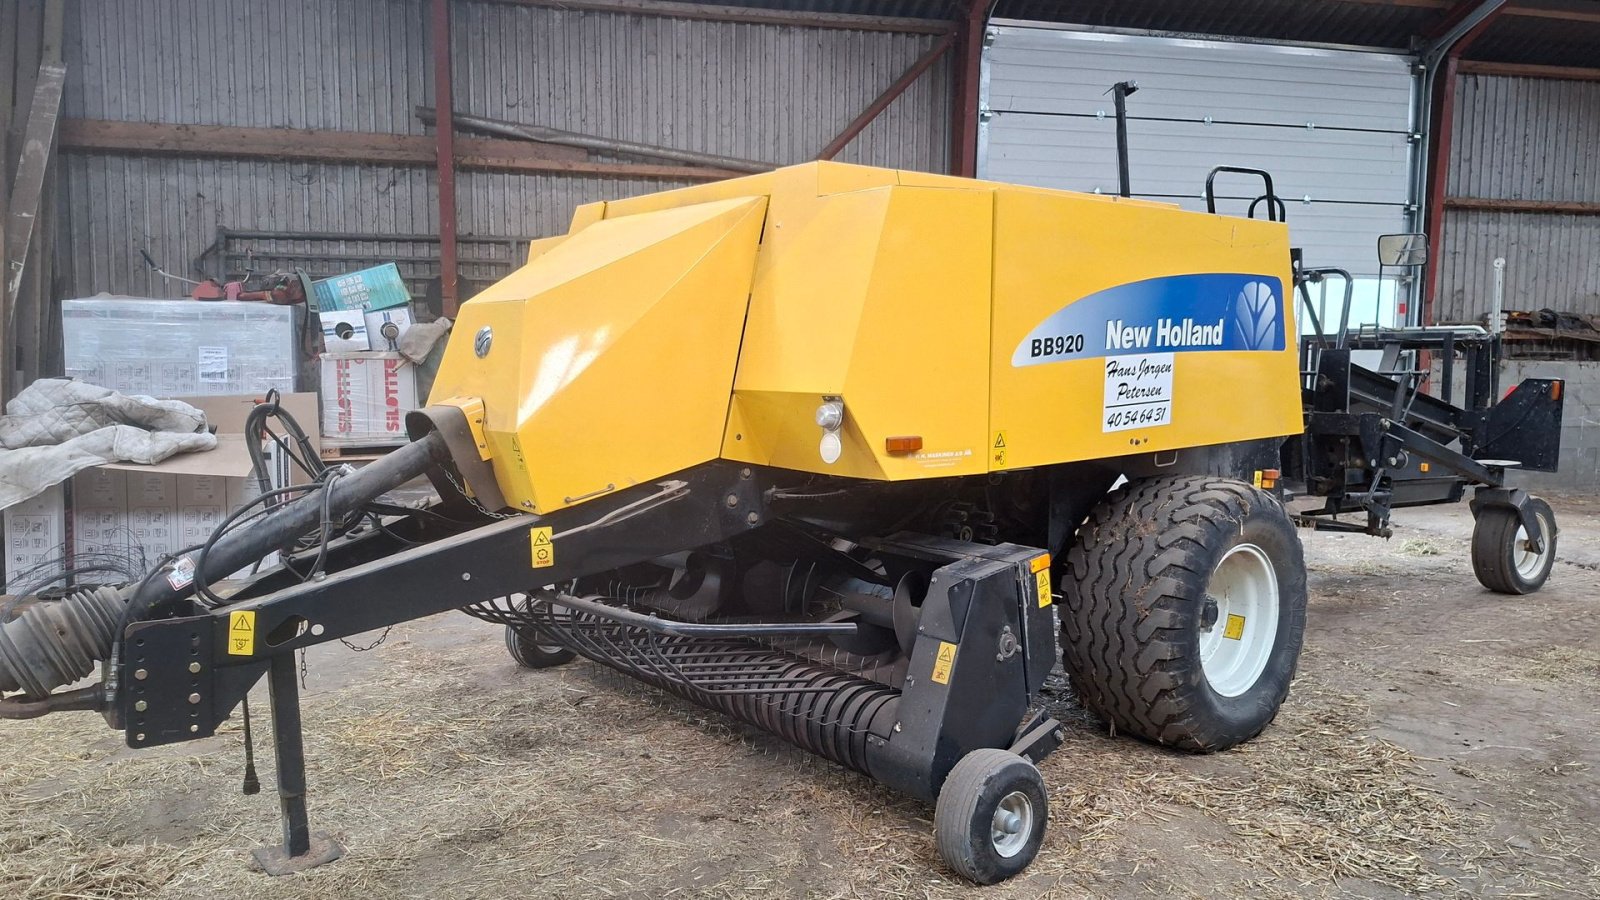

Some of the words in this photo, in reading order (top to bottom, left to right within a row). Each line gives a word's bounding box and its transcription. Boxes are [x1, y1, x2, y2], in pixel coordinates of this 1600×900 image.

[1105, 320, 1152, 349] New
[1156, 319, 1223, 346] Holland
[1031, 334, 1084, 357] BB920
[1106, 360, 1137, 378] Hans
[1117, 382, 1162, 400] Petersen
[1107, 412, 1122, 427] 40
[1123, 410, 1139, 425] 54
[1139, 408, 1154, 423] 64
[1154, 407, 1167, 421] 31
